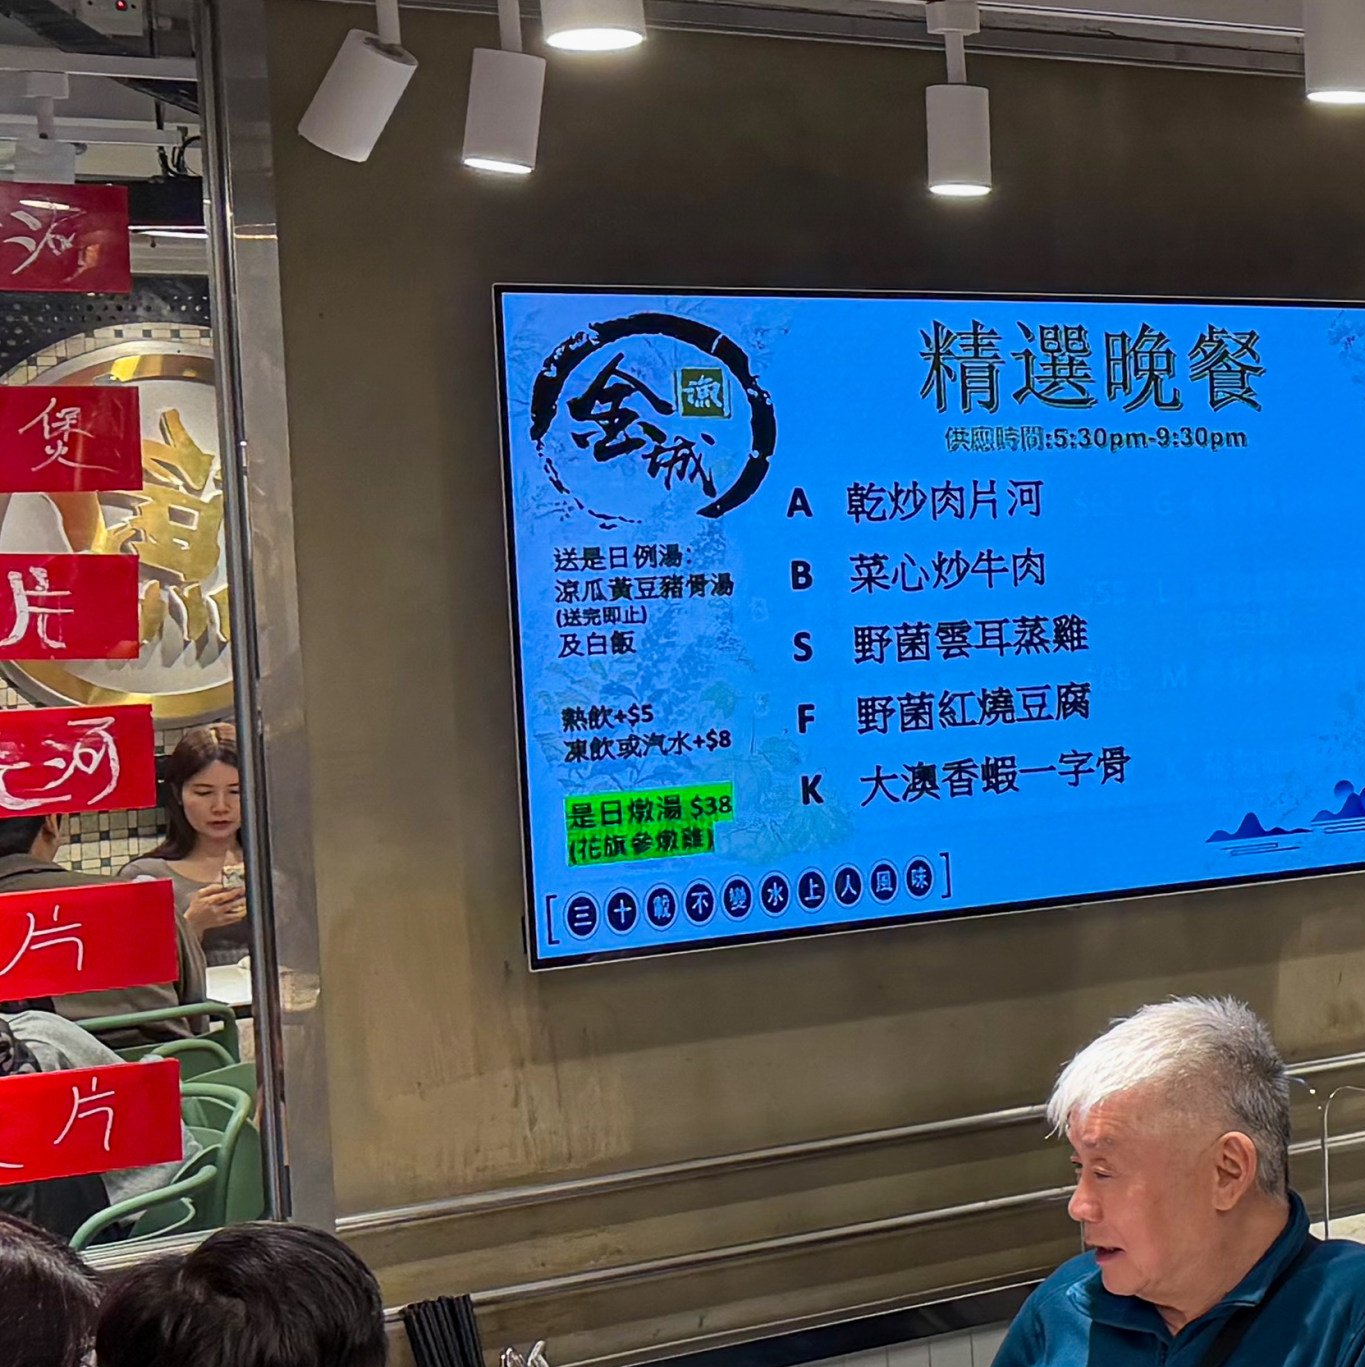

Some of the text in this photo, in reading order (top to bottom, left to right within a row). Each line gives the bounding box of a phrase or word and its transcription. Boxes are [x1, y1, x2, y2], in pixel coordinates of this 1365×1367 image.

[919, 319, 1266, 414] 精選晚餐
[786, 487, 814, 518] A
[846, 479, 1044, 523] 乾炒肉片河
[790, 560, 814, 590] B
[849, 548, 1047, 594] 菜心炒牛肉
[558, 630, 637, 658] 及白飯
[793, 631, 814, 662] S
[853, 613, 1089, 666] 野菌雲耳蒸雞
[797, 704, 816, 734] F
[857, 681, 1092, 735] 野菌紅燒豆腐
[801, 775, 825, 806] K
[859, 744, 1131, 808] 大澳香蝦一字骨
[691, 794, 733, 820] $38
